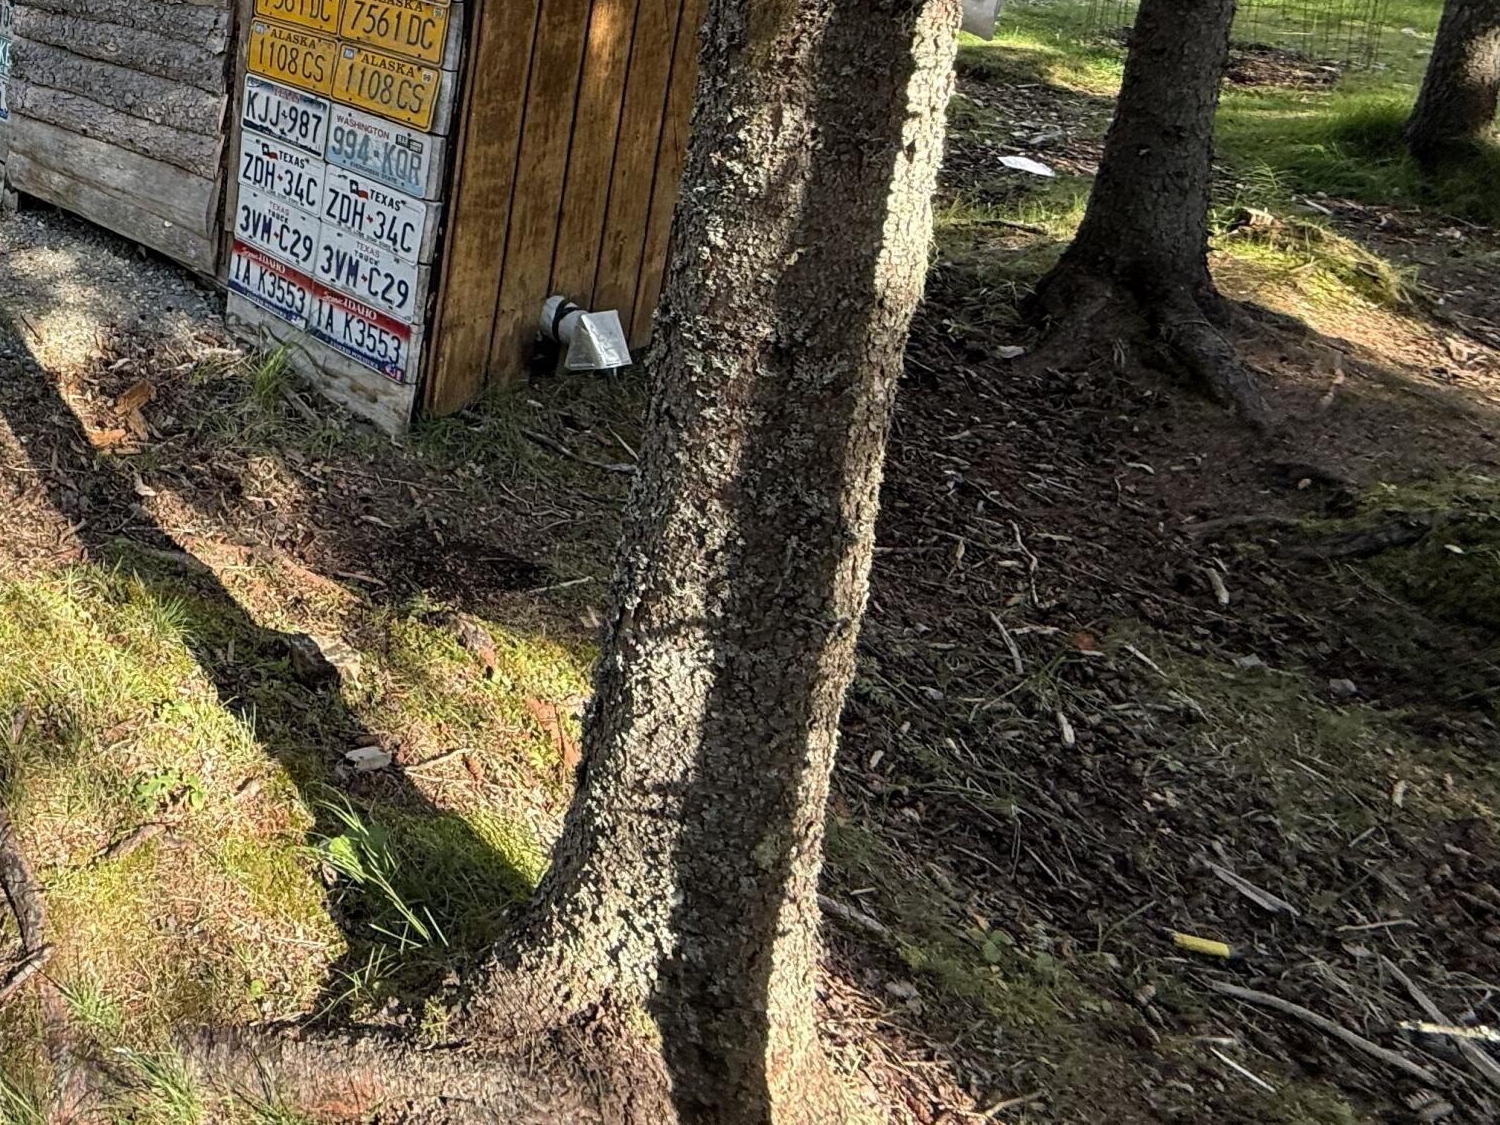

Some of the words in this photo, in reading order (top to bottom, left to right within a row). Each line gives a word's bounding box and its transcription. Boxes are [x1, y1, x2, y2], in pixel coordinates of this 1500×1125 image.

[270, 29, 316, 50] ALASKA
[351, 1, 402, 42] 7561
[407, 14, 435, 50] DC
[259, 37, 298, 75] 1108
[302, 51, 326, 82] CS
[361, 54, 414, 77] ALASKA
[398, 80, 425, 114] CS
[287, 106, 323, 144] 987
[336, 114, 390, 140] WASHINGTON
[277, 150, 305, 169] TEXAS
[332, 126, 370, 163] 994
[242, 153, 276, 190] ZDH
[283, 169, 318, 207] 34C
[370, 190, 400, 211] TEXAS
[326, 188, 365, 230] ZDH
[373, 211, 415, 254] 34C
[278, 224, 313, 263] C29
[258, 254, 286, 274] IDAHO
[368, 267, 409, 310] C29
[344, 299, 378, 321] IDAHO
[344, 313, 401, 366] K3553
